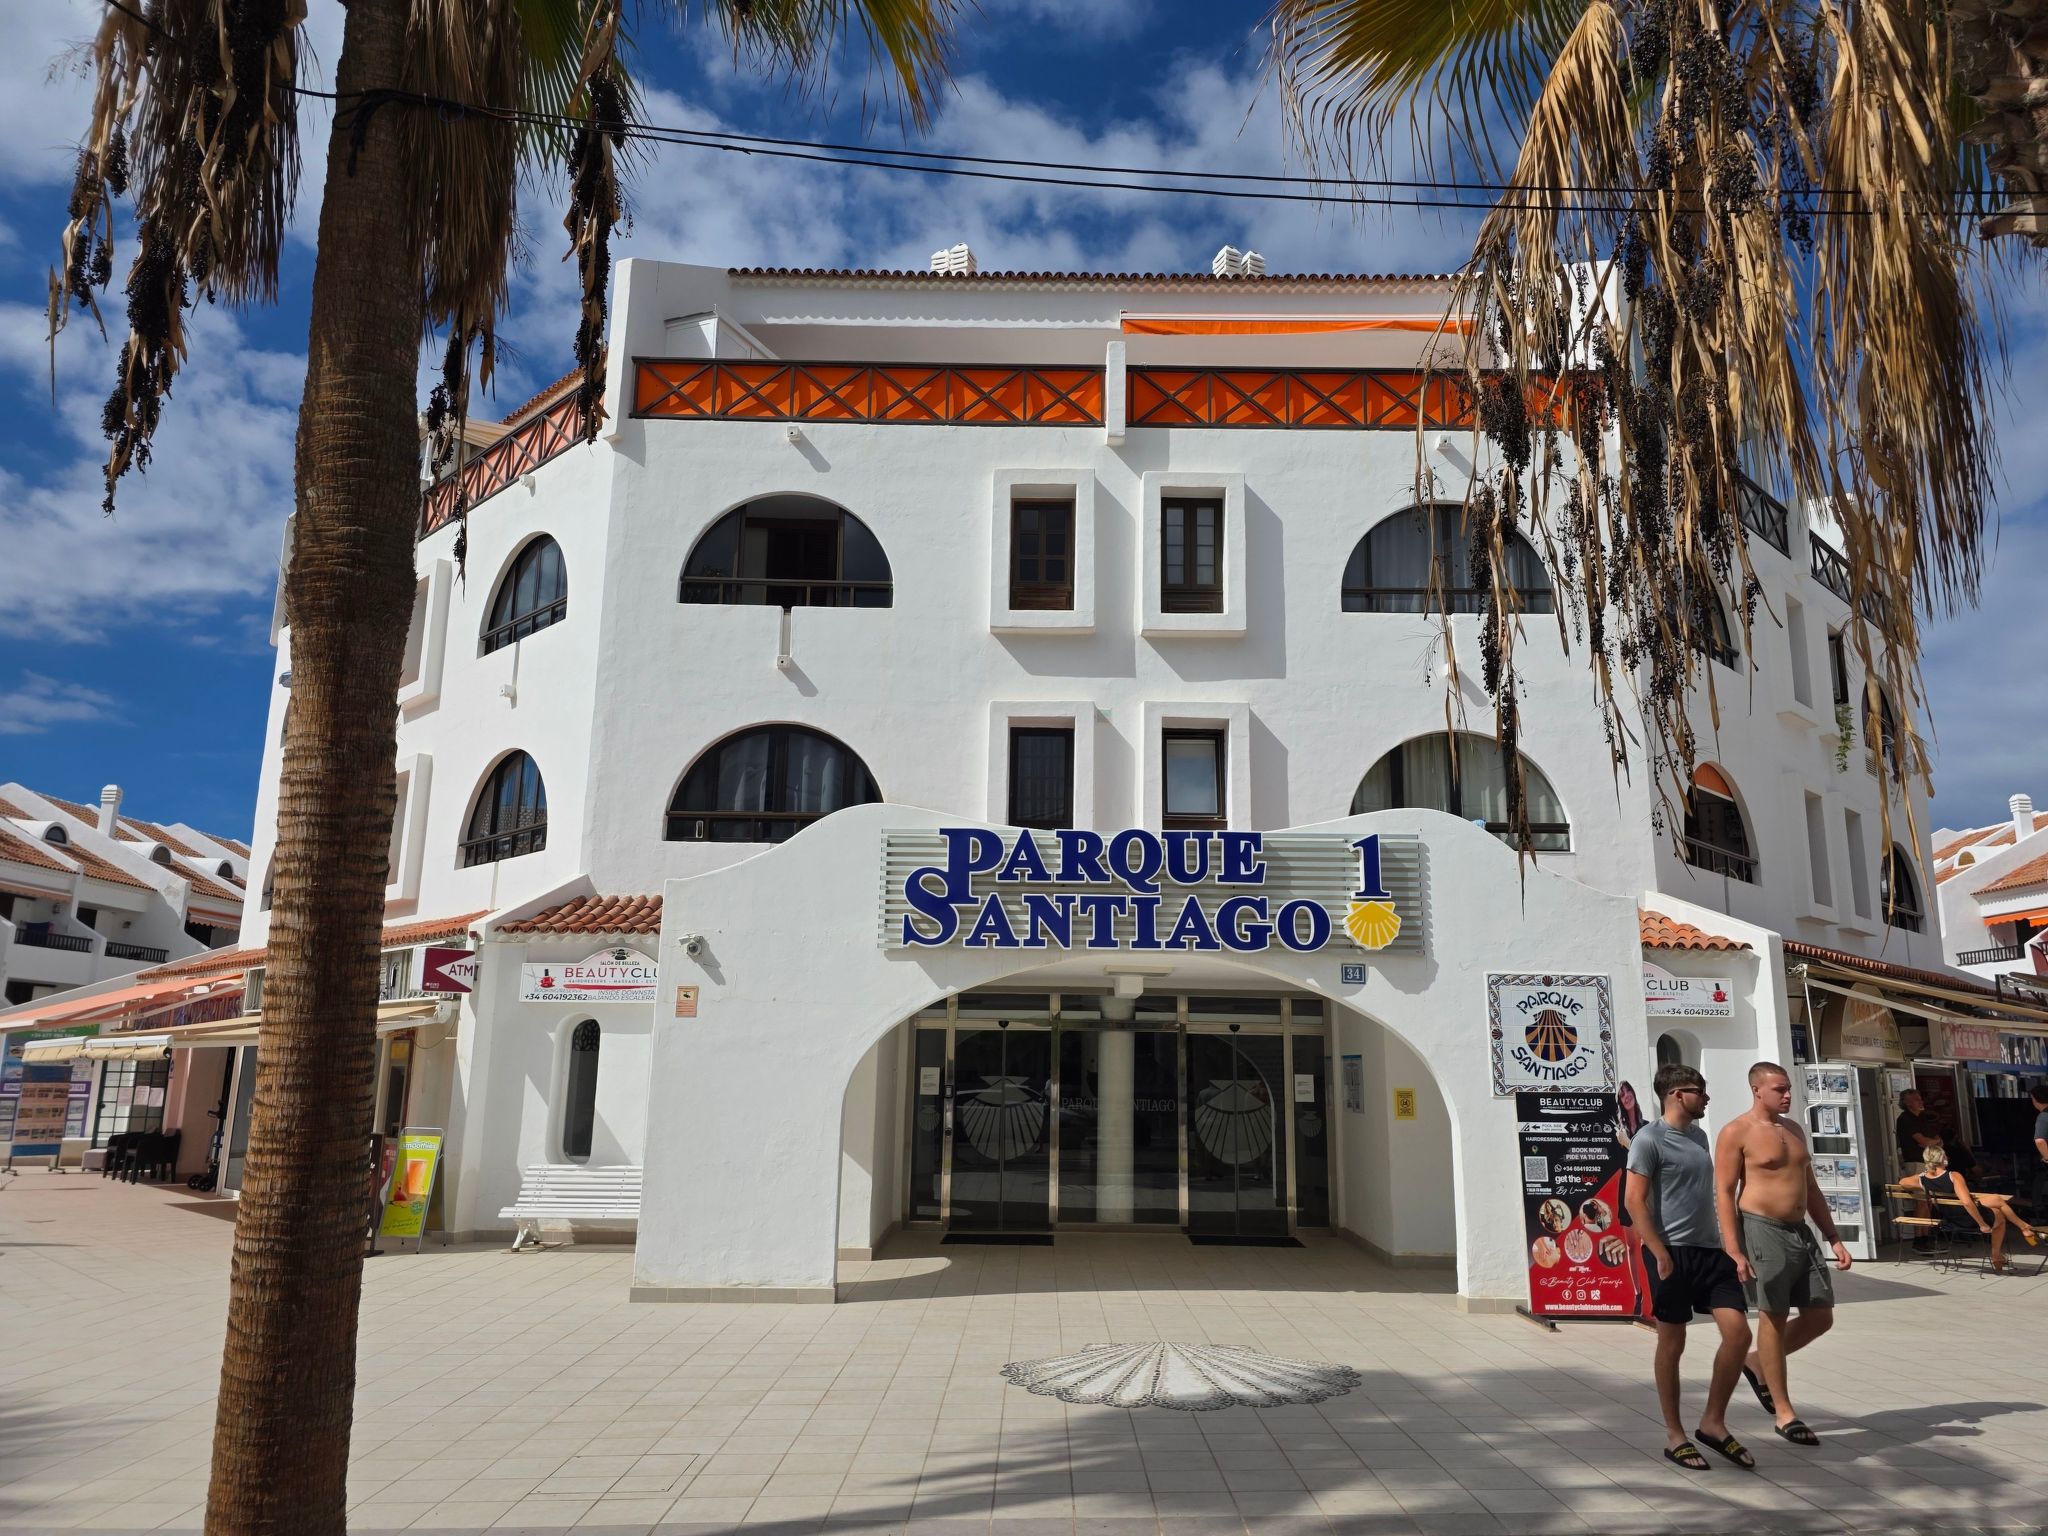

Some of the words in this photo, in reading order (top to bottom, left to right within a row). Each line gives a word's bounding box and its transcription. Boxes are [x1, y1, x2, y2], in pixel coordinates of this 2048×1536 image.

[939, 827, 1268, 905] PARQUE
[1348, 833, 1391, 899] 1
[902, 866, 1332, 952] SANTIAGO
[448, 964, 474, 977] ATM
[1346, 968, 1361, 980] 34
[1646, 980, 1690, 991] CLUB
[1516, 992, 1583, 1016] PARQUE
[1683, 1008, 1730, 1016] 604192362
[1954, 1031, 1991, 1051] KEBAB
[1511, 1046, 1588, 1081] SANTIAGO
[1581, 1046, 1595, 1055] 1
[1540, 1098, 1603, 1106] BEAUTYCLUB
[1555, 1175, 1567, 1184] get
[1568, 1175, 1581, 1183] the
[1581, 1174, 1598, 1183] look
